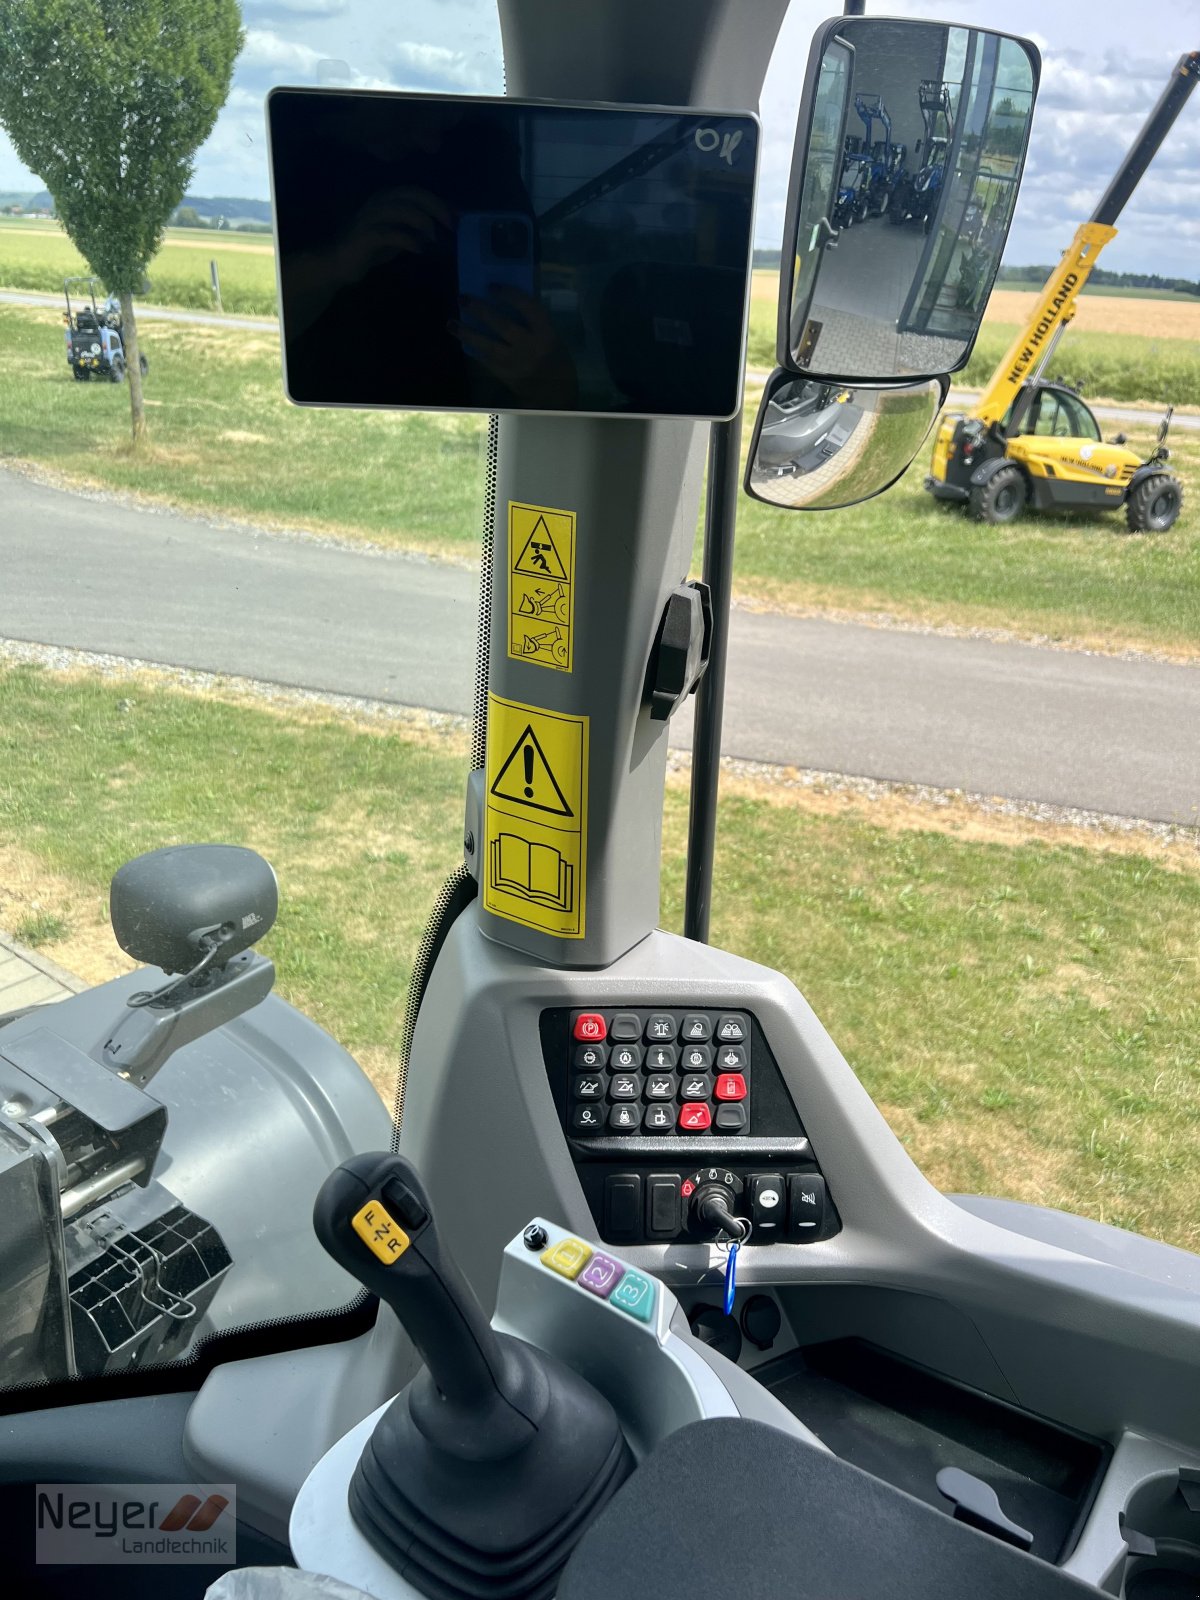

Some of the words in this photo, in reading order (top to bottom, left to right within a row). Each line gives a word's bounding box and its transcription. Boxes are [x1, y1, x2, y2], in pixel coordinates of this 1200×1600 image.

[1008, 347, 1034, 384] NEW
[1030, 272, 1078, 347] HOLLAND
[364, 1210, 375, 1227] F
[387, 1238, 402, 1254] R
[591, 1266, 608, 1281] 2
[622, 1284, 639, 1299] 3
